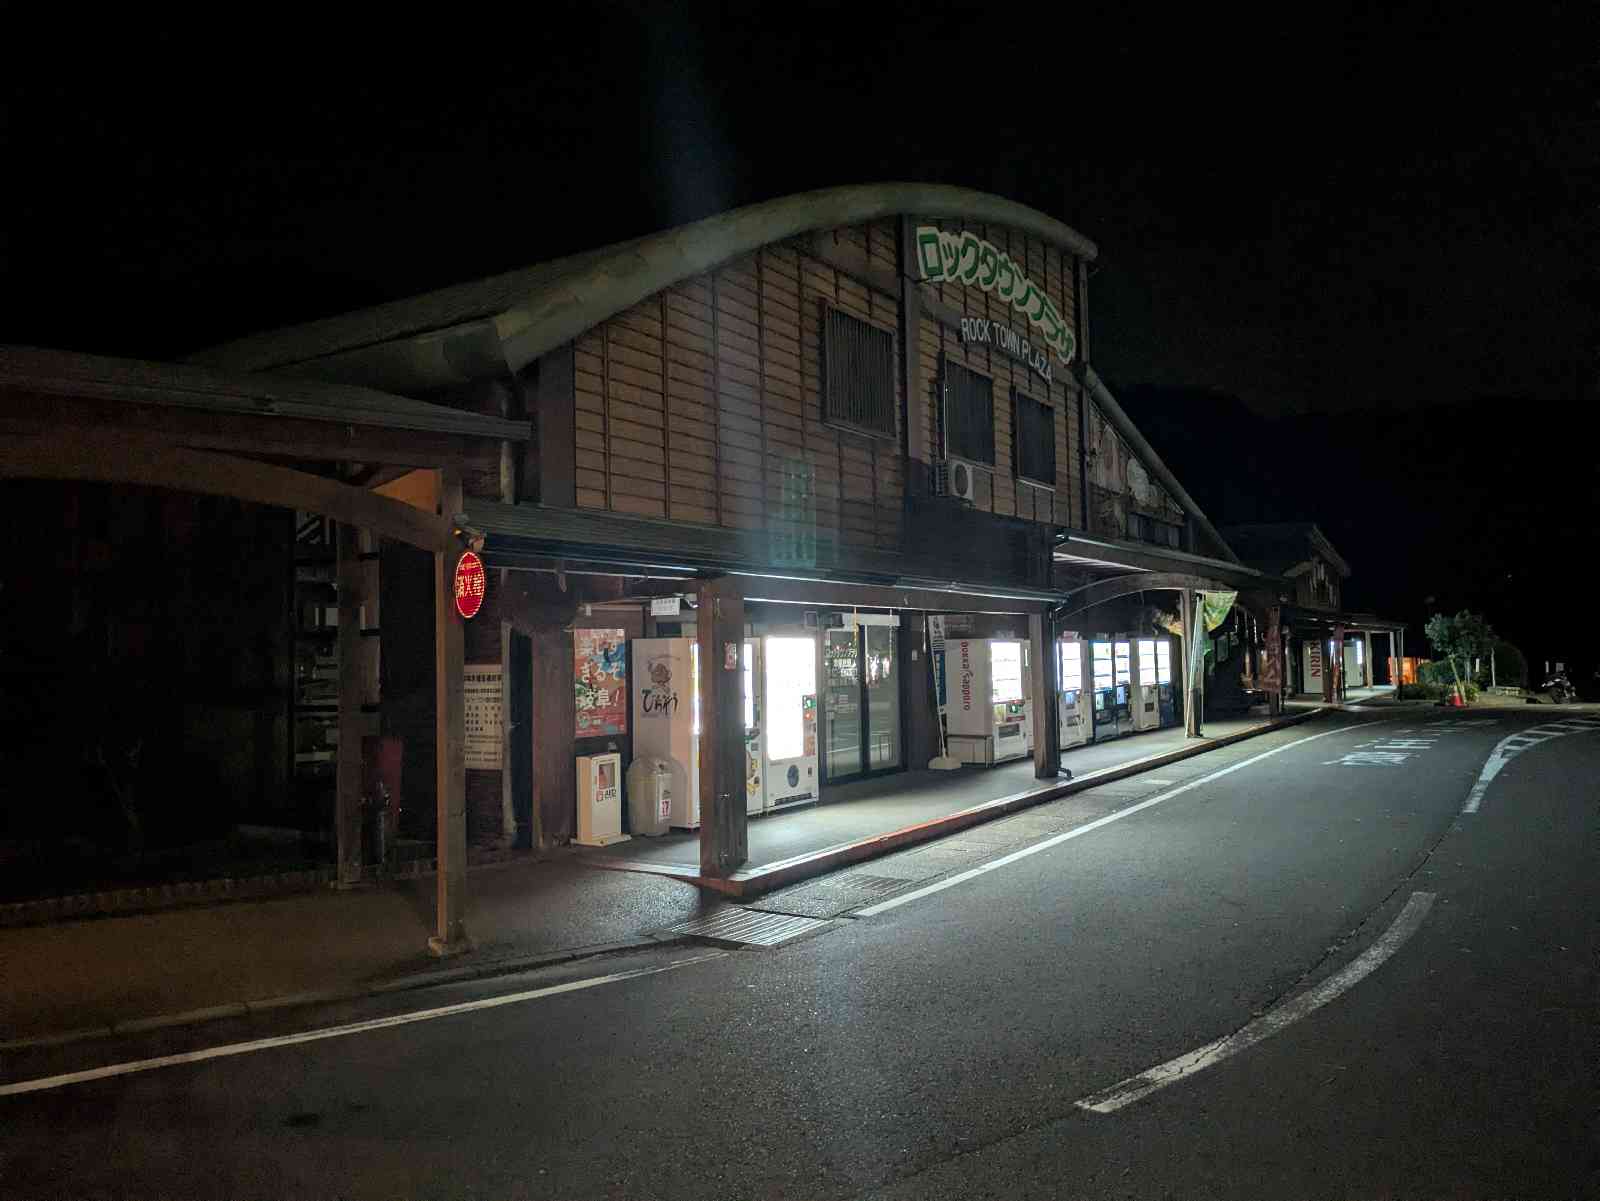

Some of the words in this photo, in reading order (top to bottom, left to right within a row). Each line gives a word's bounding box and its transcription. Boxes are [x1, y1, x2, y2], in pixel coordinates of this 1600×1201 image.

[916, 226, 1076, 364] ロックタウンプラザ
[960, 318, 991, 344] ROCK
[993, 322, 1020, 356] TOWN
[1022, 339, 1053, 386] PLAZA
[1311, 639, 1321, 678] KIRIN
